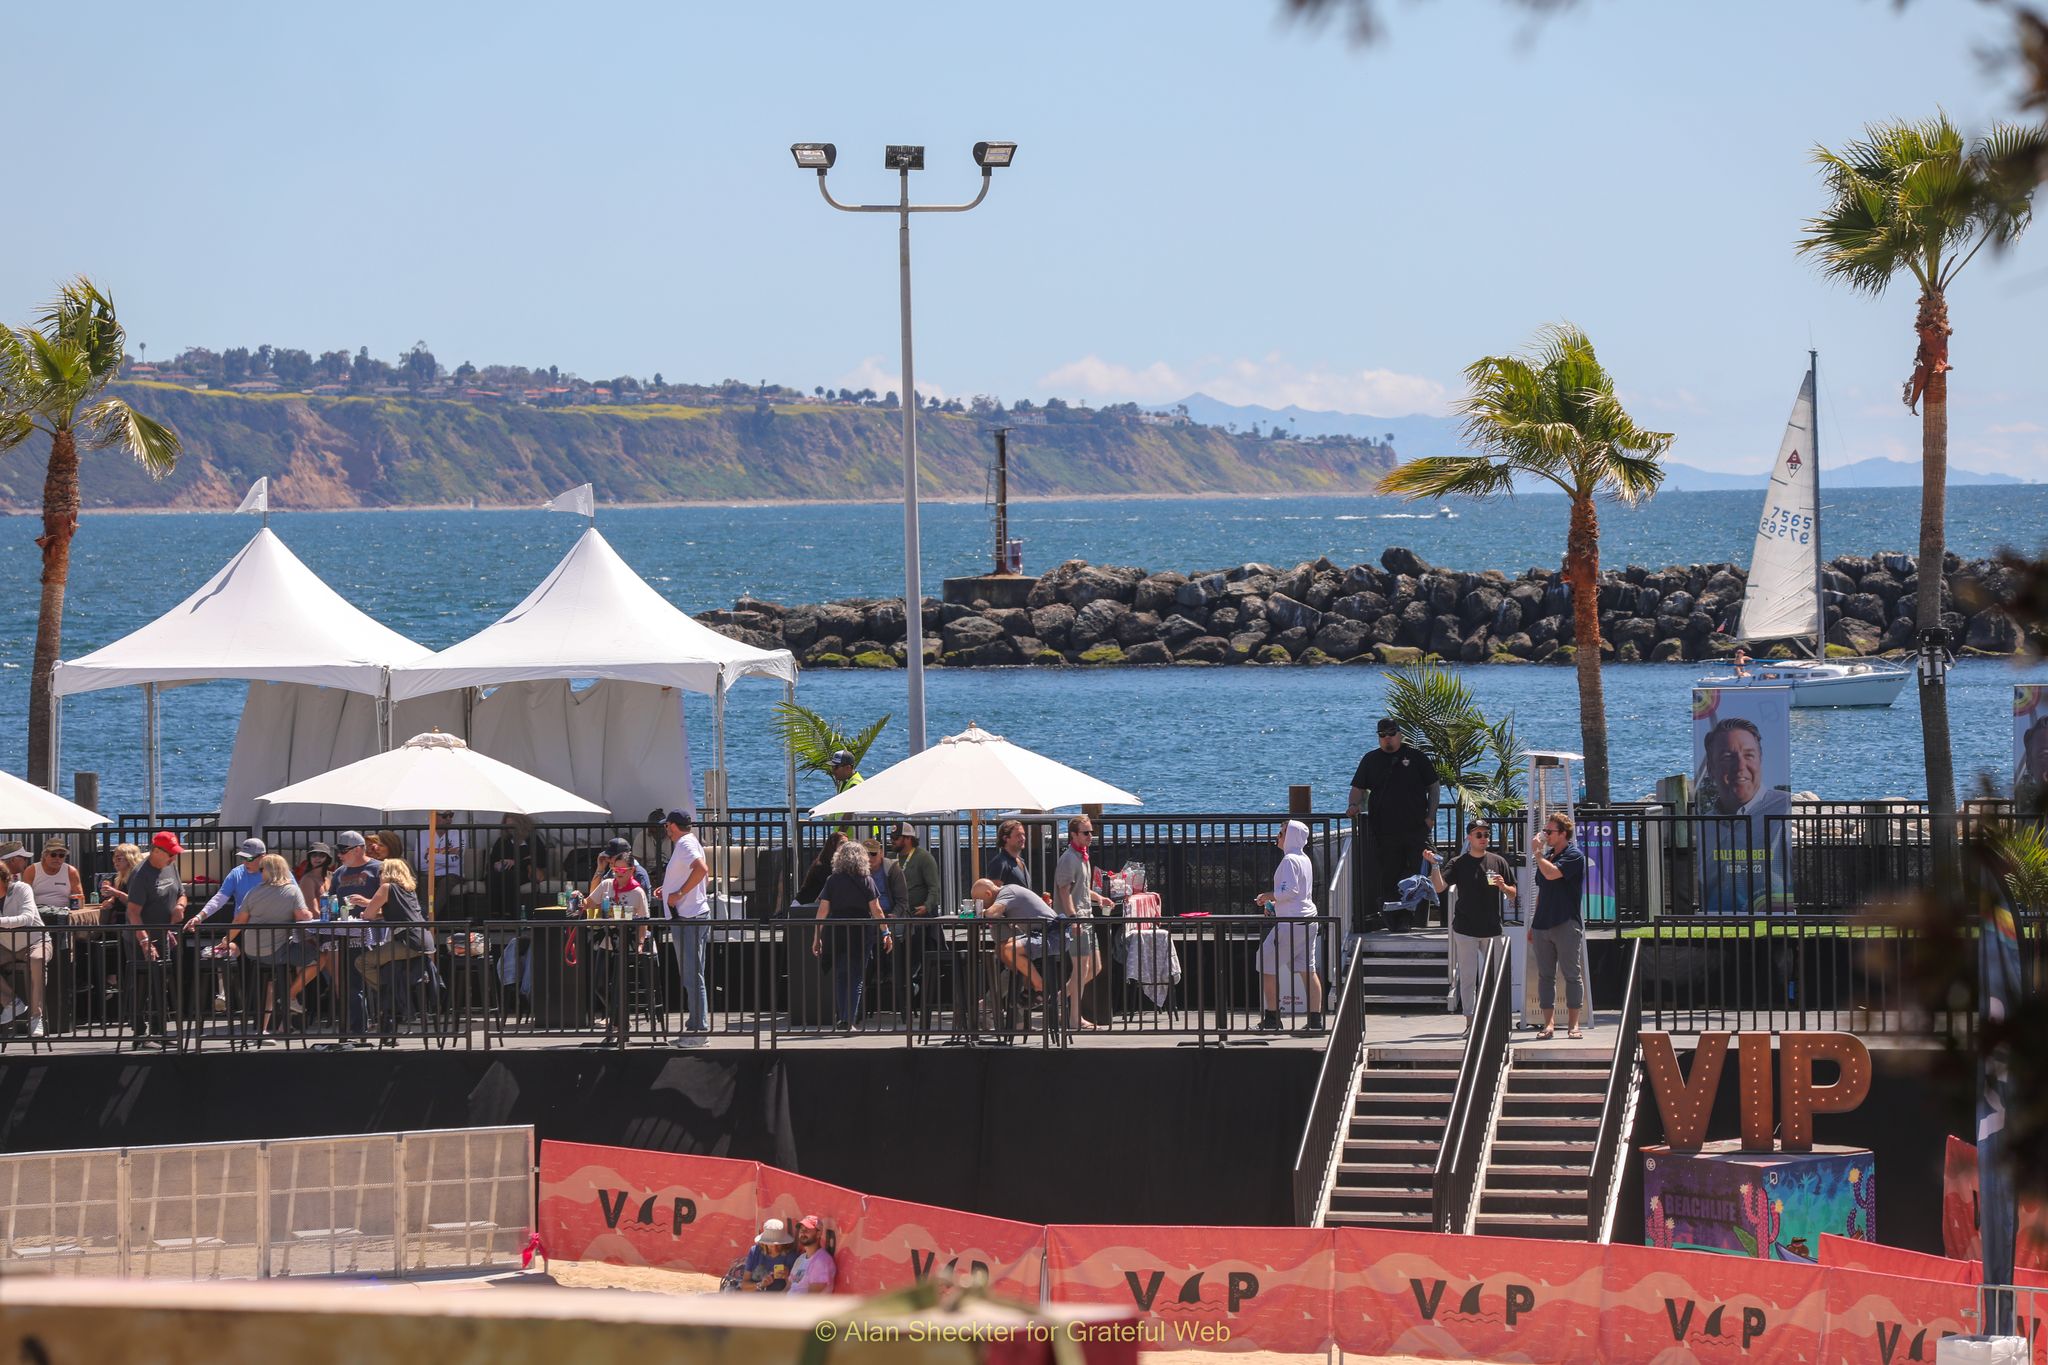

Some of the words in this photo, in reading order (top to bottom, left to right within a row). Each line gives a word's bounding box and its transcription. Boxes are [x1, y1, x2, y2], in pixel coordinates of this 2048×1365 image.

[1771, 506, 1812, 530] 7565
[1640, 1030, 1873, 1152] VIP
[1663, 1192, 1738, 1222] BEACHLIFE
